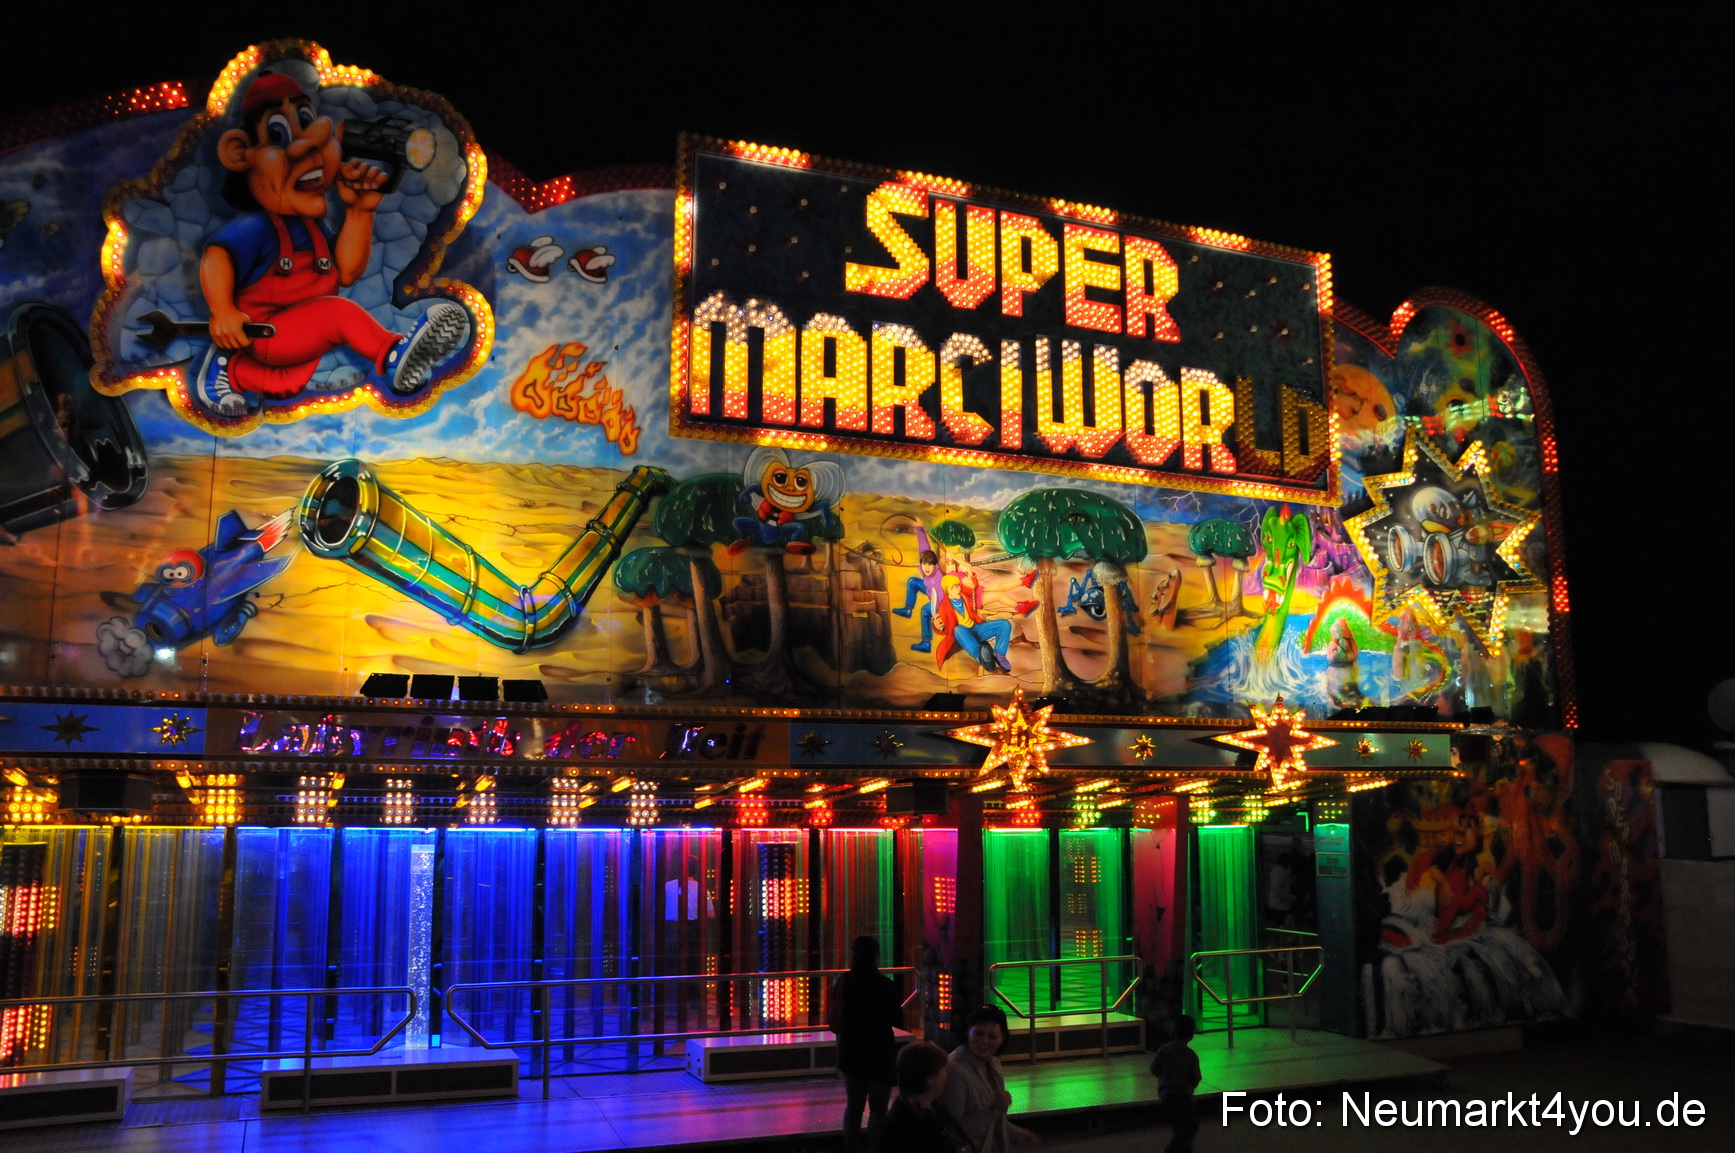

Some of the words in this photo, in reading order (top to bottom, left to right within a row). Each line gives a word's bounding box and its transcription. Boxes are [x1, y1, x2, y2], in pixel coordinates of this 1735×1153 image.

[844, 180, 1182, 344] SUPER
[233, 710, 522, 757] Labyrinth
[544, 720, 637, 759] der
